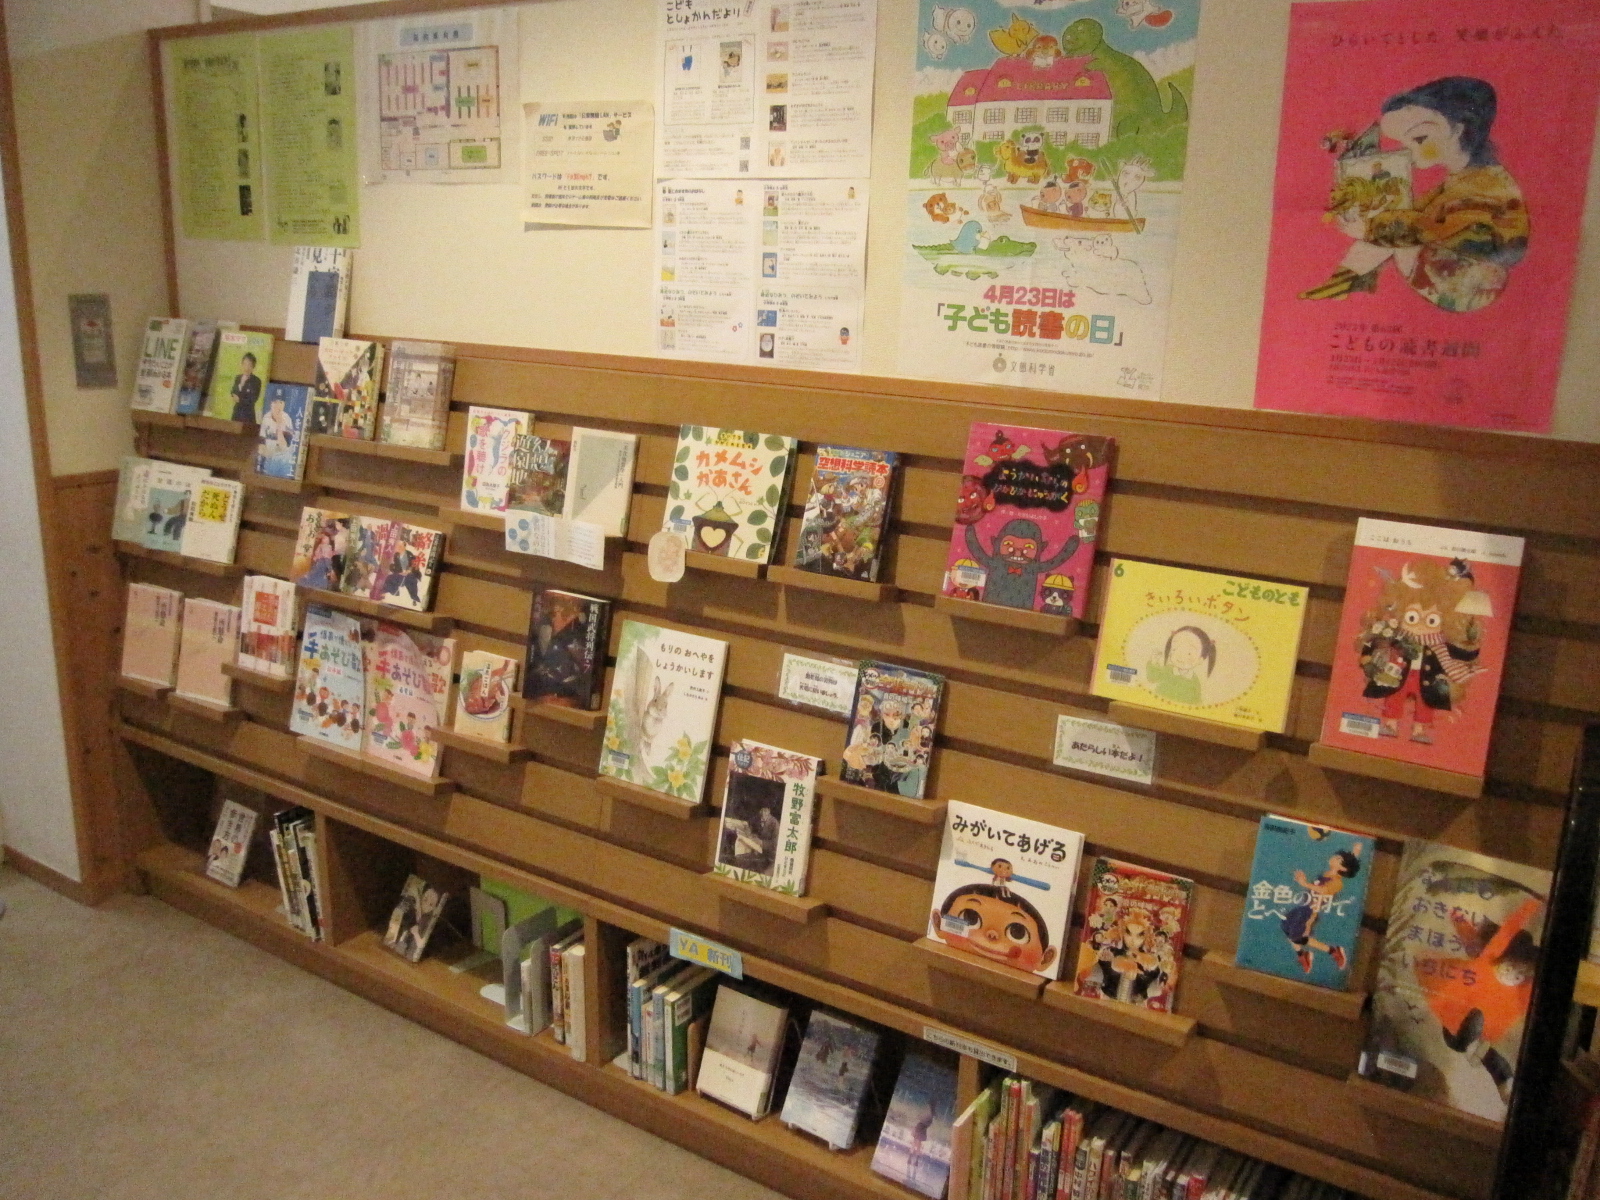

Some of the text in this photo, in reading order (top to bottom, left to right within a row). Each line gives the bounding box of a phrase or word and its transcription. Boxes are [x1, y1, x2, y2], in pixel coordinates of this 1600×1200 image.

[666, 9, 741, 25] としょかんだより
[983, 285, 1076, 308] 4月23日は
[937, 303, 1124, 347] 「子ども読書の日」
[497, 430, 511, 477] クジラの
[695, 449, 763, 476] カメムシ
[816, 456, 890, 475] 空想科学読本
[696, 469, 752, 496] かあさん
[1114, 563, 1125, 577] 6
[1145, 589, 1250, 622] きいろいボタン
[1222, 580, 1300, 607] こどものとも
[660, 643, 715, 664] もりの おへやを
[655, 659, 714, 680] しょうかいします
[784, 782, 806, 854] 牧野富太郎
[952, 814, 1067, 863] みがいてあげる
[1247, 900, 1288, 920] とべ
[1251, 880, 1356, 917] 金色の羽で
